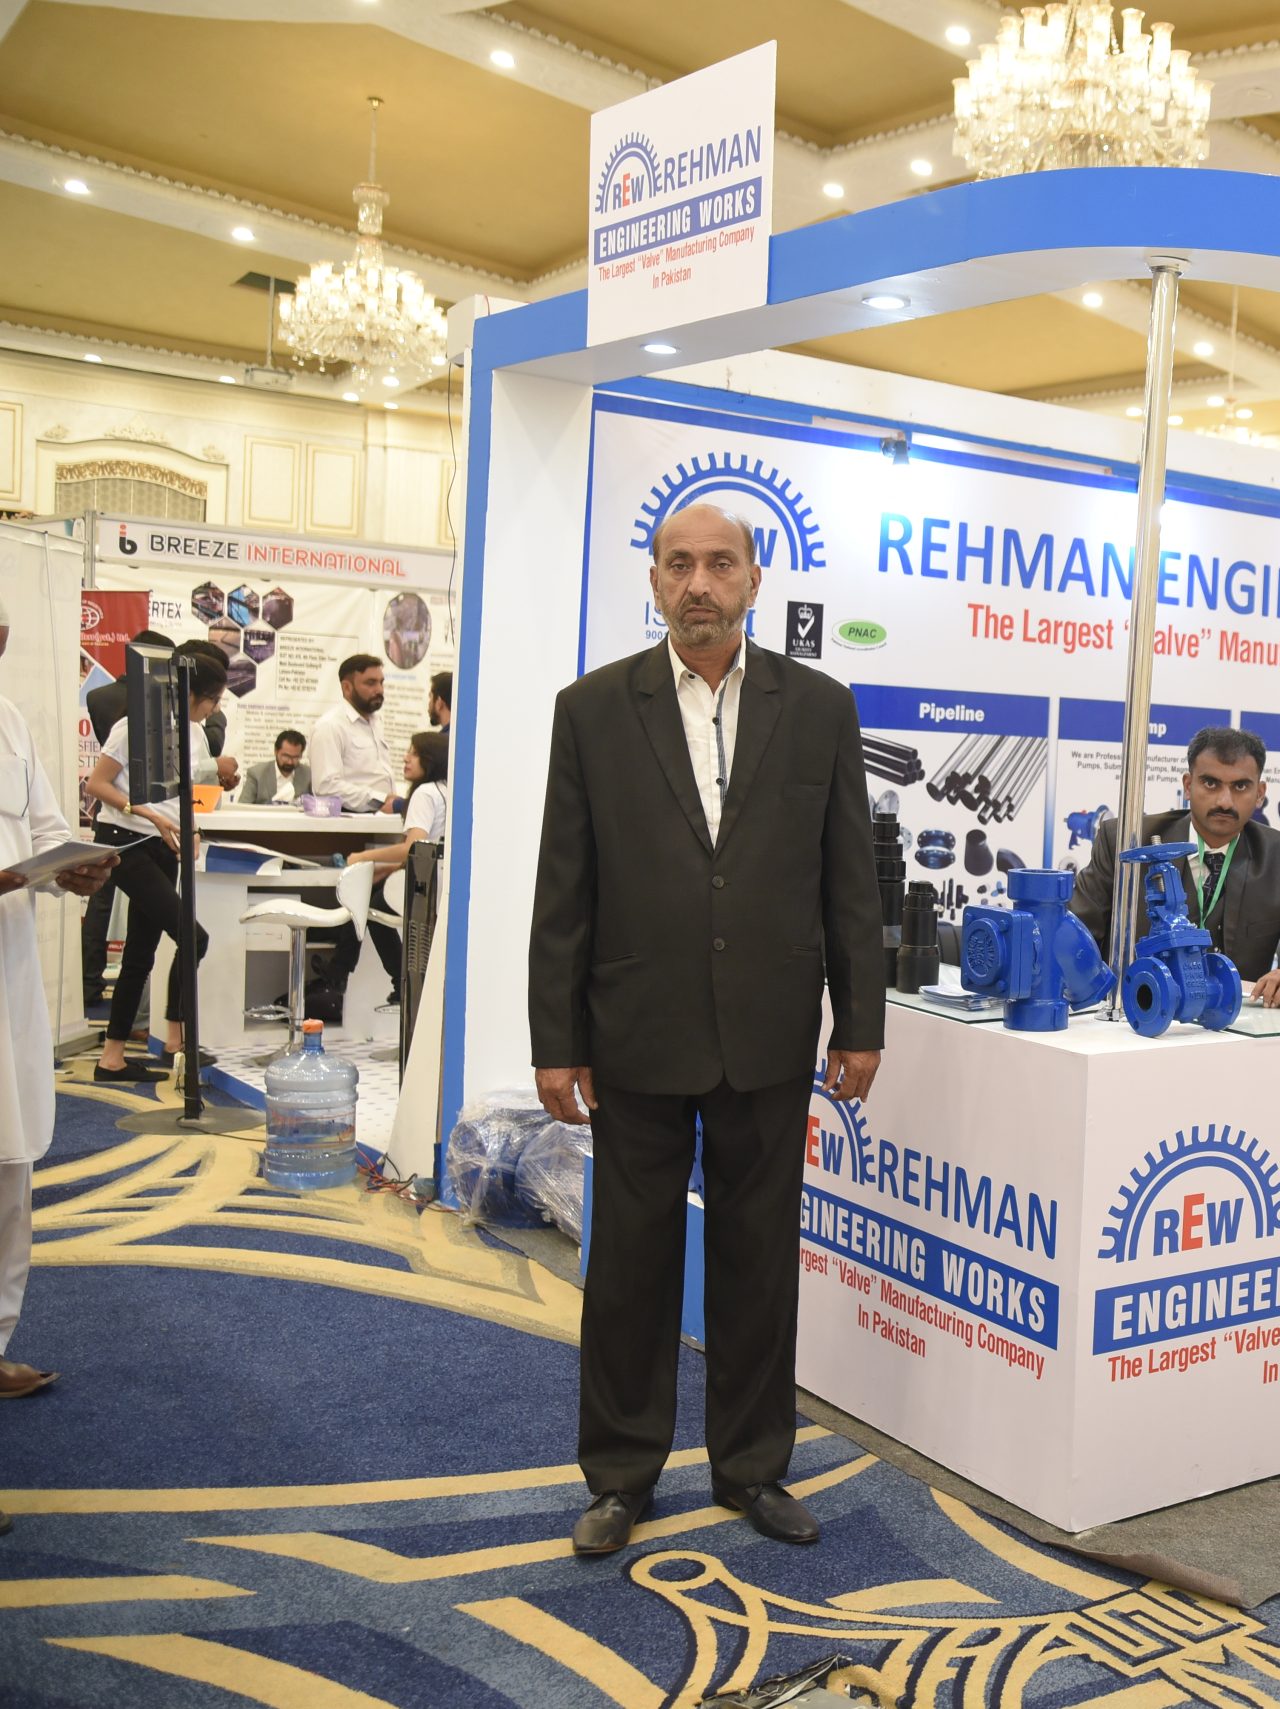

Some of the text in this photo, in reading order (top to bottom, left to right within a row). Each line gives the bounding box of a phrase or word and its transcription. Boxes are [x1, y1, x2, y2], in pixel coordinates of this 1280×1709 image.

[663, 125, 762, 194] REHMAN
[612, 172, 645, 210] REW
[599, 184, 755, 258] ENGINEERING WORKS
[599, 266, 611, 281] The
[611, 259, 636, 279] Largest
[665, 235, 717, 260] Manufacturing
[719, 226, 755, 248] Company
[652, 266, 692, 289] In Pakistan
[150, 533, 407, 577] BREEZE INTERNATIONAL
[878, 511, 1135, 602] REHMAN
[792, 638, 815, 648] UKAS
[847, 627, 877, 639] PNAC
[967, 602, 1014, 641] The
[1022, 606, 1114, 655] Largest
[919, 703, 985, 723] Pipeline
[1071, 750, 1083, 759] We
[804, 1113, 845, 1176] EW
[877, 1138, 1058, 1260] REHMAN
[1152, 1192, 1245, 1257] REW
[800, 1189, 1046, 1333] GINEERING WORKS
[800, 1247, 829, 1277] rgest
[880, 1278, 974, 1349] Manufacturing
[977, 1323, 1045, 1380] Company
[858, 1303, 926, 1358] In Pakistan
[1108, 1355, 1143, 1382] The
[1147, 1335, 1217, 1374] Largest
[1262, 1359, 1279, 1384] In
